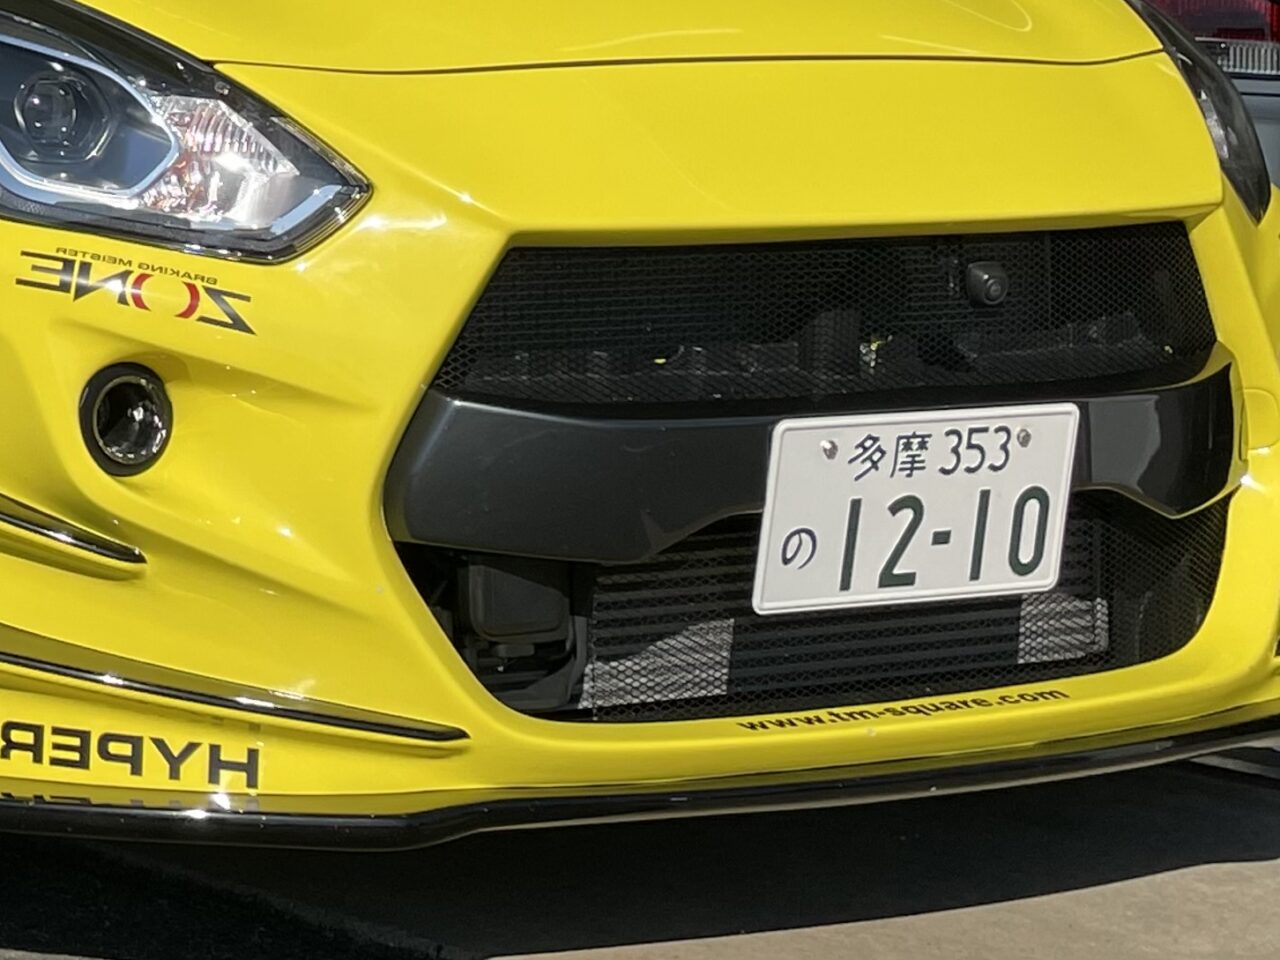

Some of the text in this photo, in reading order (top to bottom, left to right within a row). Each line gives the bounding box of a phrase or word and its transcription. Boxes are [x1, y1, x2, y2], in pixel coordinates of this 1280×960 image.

[847, 425, 1013, 482] 多摩 353
[781, 485, 1051, 592] の 12-10
[736, 687, 1070, 732] www.tm-square.com
